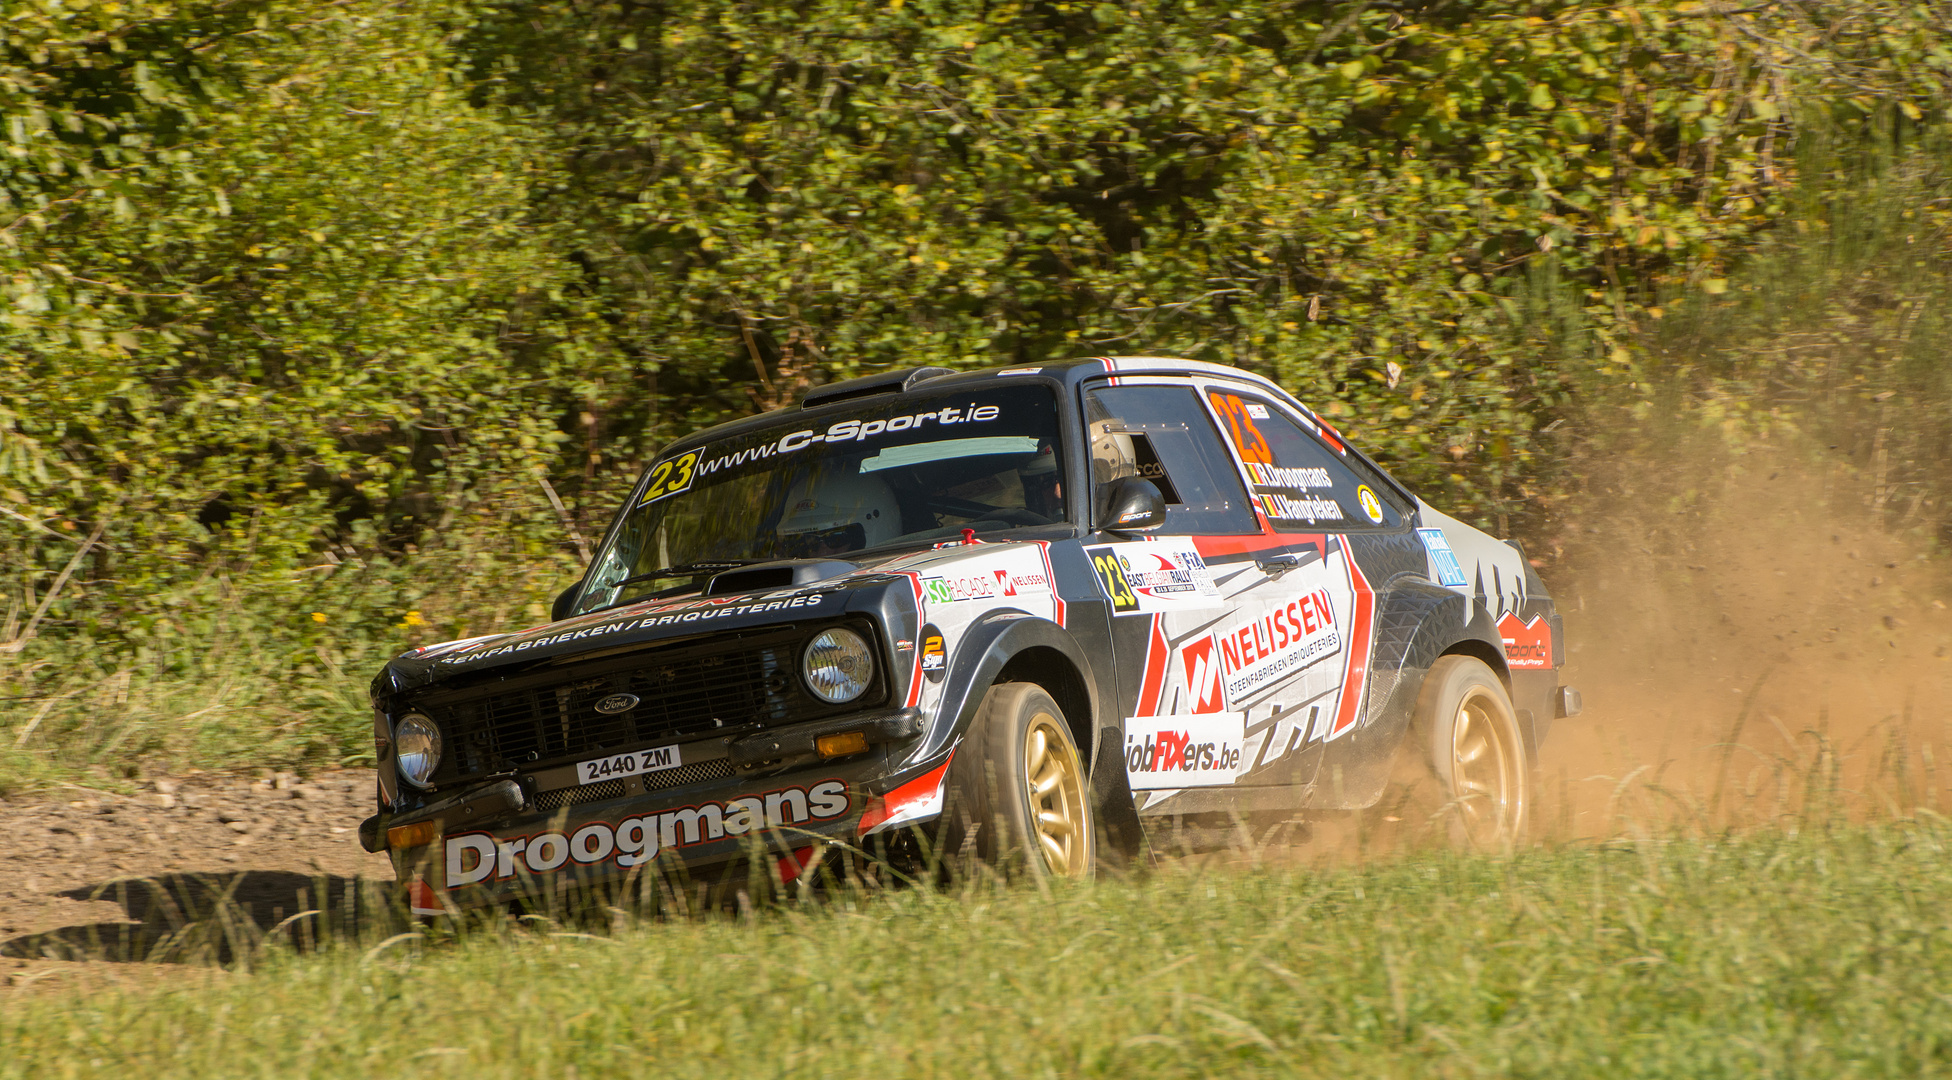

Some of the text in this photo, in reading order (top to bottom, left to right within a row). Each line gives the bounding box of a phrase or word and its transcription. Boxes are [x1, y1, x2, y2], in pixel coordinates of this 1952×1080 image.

[1210, 392, 1273, 464] 23
[641, 453, 697, 503] 23
[1011, 574, 1047, 586] NELISSEN
[1095, 554, 1136, 607] 23
[923, 636, 945, 659] 2
[1220, 588, 1333, 676] NELISSEN
[604, 696, 628, 710] Ford
[586, 748, 672, 780] 2440 ZM
[444, 778, 851, 890] Droogmans
